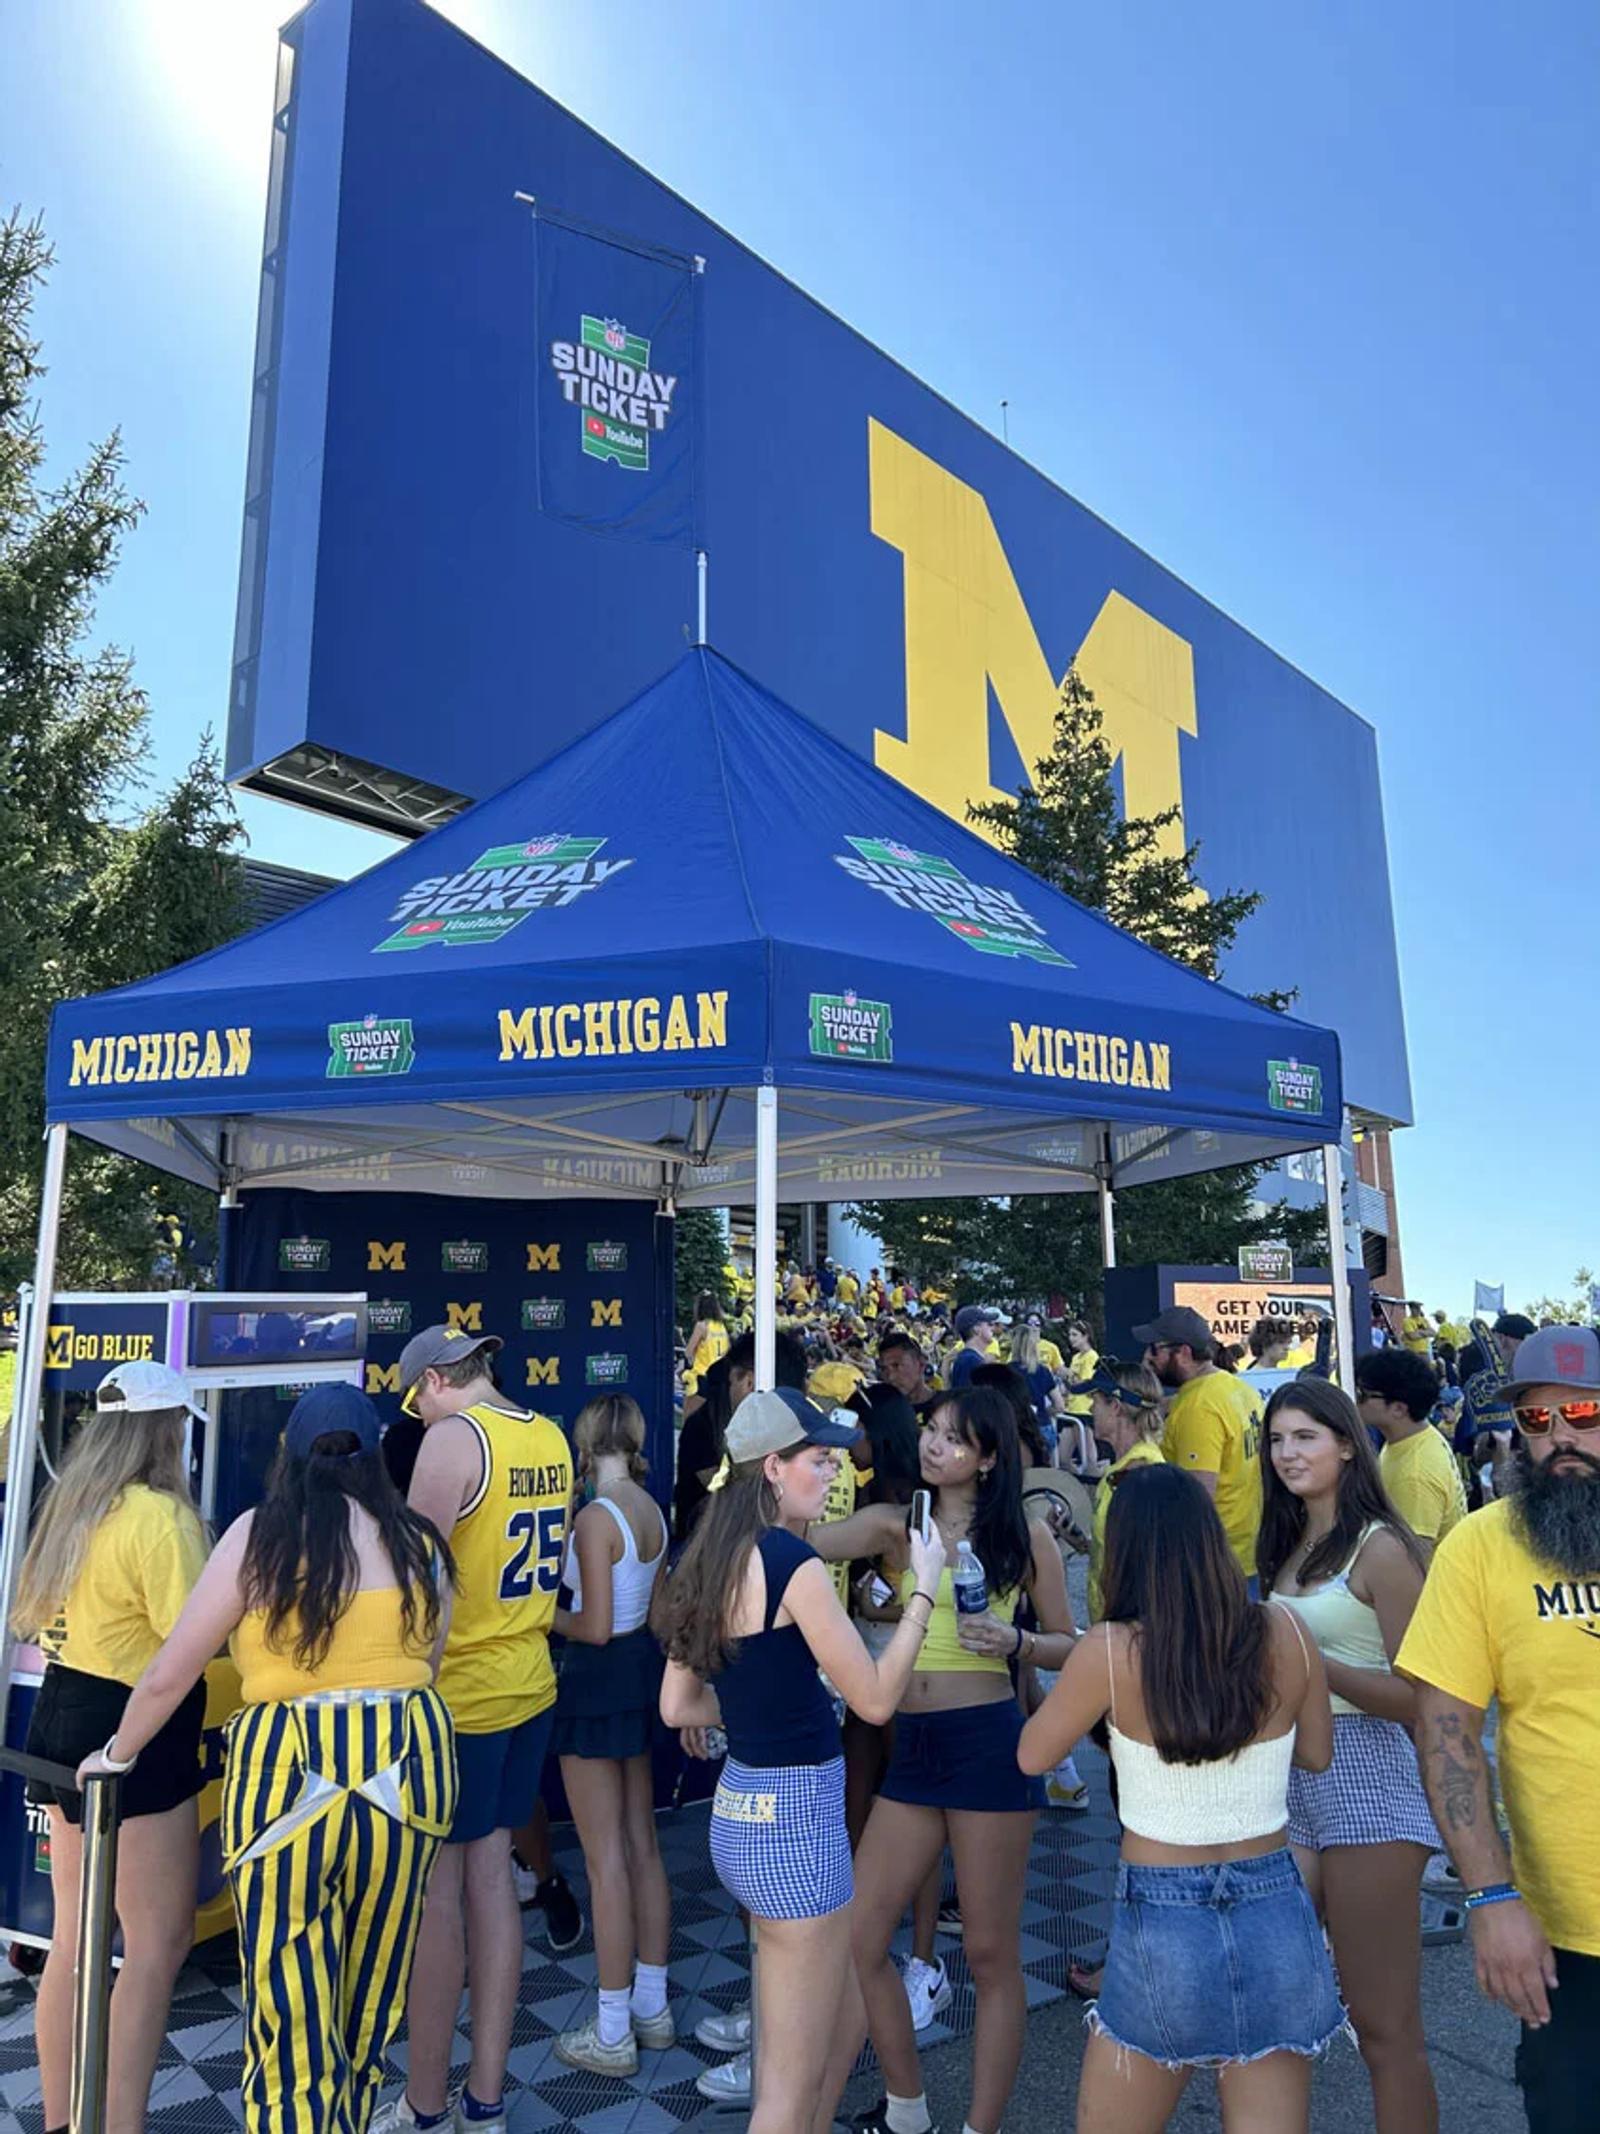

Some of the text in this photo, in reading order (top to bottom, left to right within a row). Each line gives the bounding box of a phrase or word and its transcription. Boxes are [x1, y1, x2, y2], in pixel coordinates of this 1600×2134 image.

[552, 341, 677, 402] SUNDAY
[558, 371, 671, 430] TICKET
[605, 425, 643, 449] YouTube
[400, 858, 636, 900] SUNDAY
[833, 855, 1025, 913] SUNDAY
[388, 883, 598, 922] TICKET
[867, 882, 1047, 936] TICKET
[443, 917, 515, 931] YouTube
[498, 991, 729, 1061] MICHIGAN
[821, 1005, 880, 1028] SUNDAY
[340, 1029, 400, 1047] SUNDAY
[824, 1022, 878, 1045] TICKET
[69, 1027, 252, 1087] MICHIGAN
[344, 1045, 400, 1062] TICKET
[1010, 1021, 1171, 1092] MICHIGAN
[1275, 1070, 1314, 1087] SUNDAY
[1278, 1084, 1313, 1101] TICKET
[286, 1244, 323, 1253] SUNDAY
[287, 1253, 320, 1263] TICKET
[367, 1242, 406, 1271] M
[526, 1244, 561, 1271] M
[1248, 1253, 1285, 1264] SUNDAY
[1250, 1263, 1283, 1272] TICKET
[591, 1299, 622, 1327] M
[1217, 1300, 1304, 1316] GET YOUR
[1211, 1320, 1250, 1335] AME
[1256, 1320, 1299, 1335] FACE
[75, 1334, 98, 1360] GO
[101, 1334, 153, 1361] BLUE
[526, 1357, 560, 1386] M
[508, 1464, 568, 1497] HOWARD
[498, 1505, 568, 1602] 25
